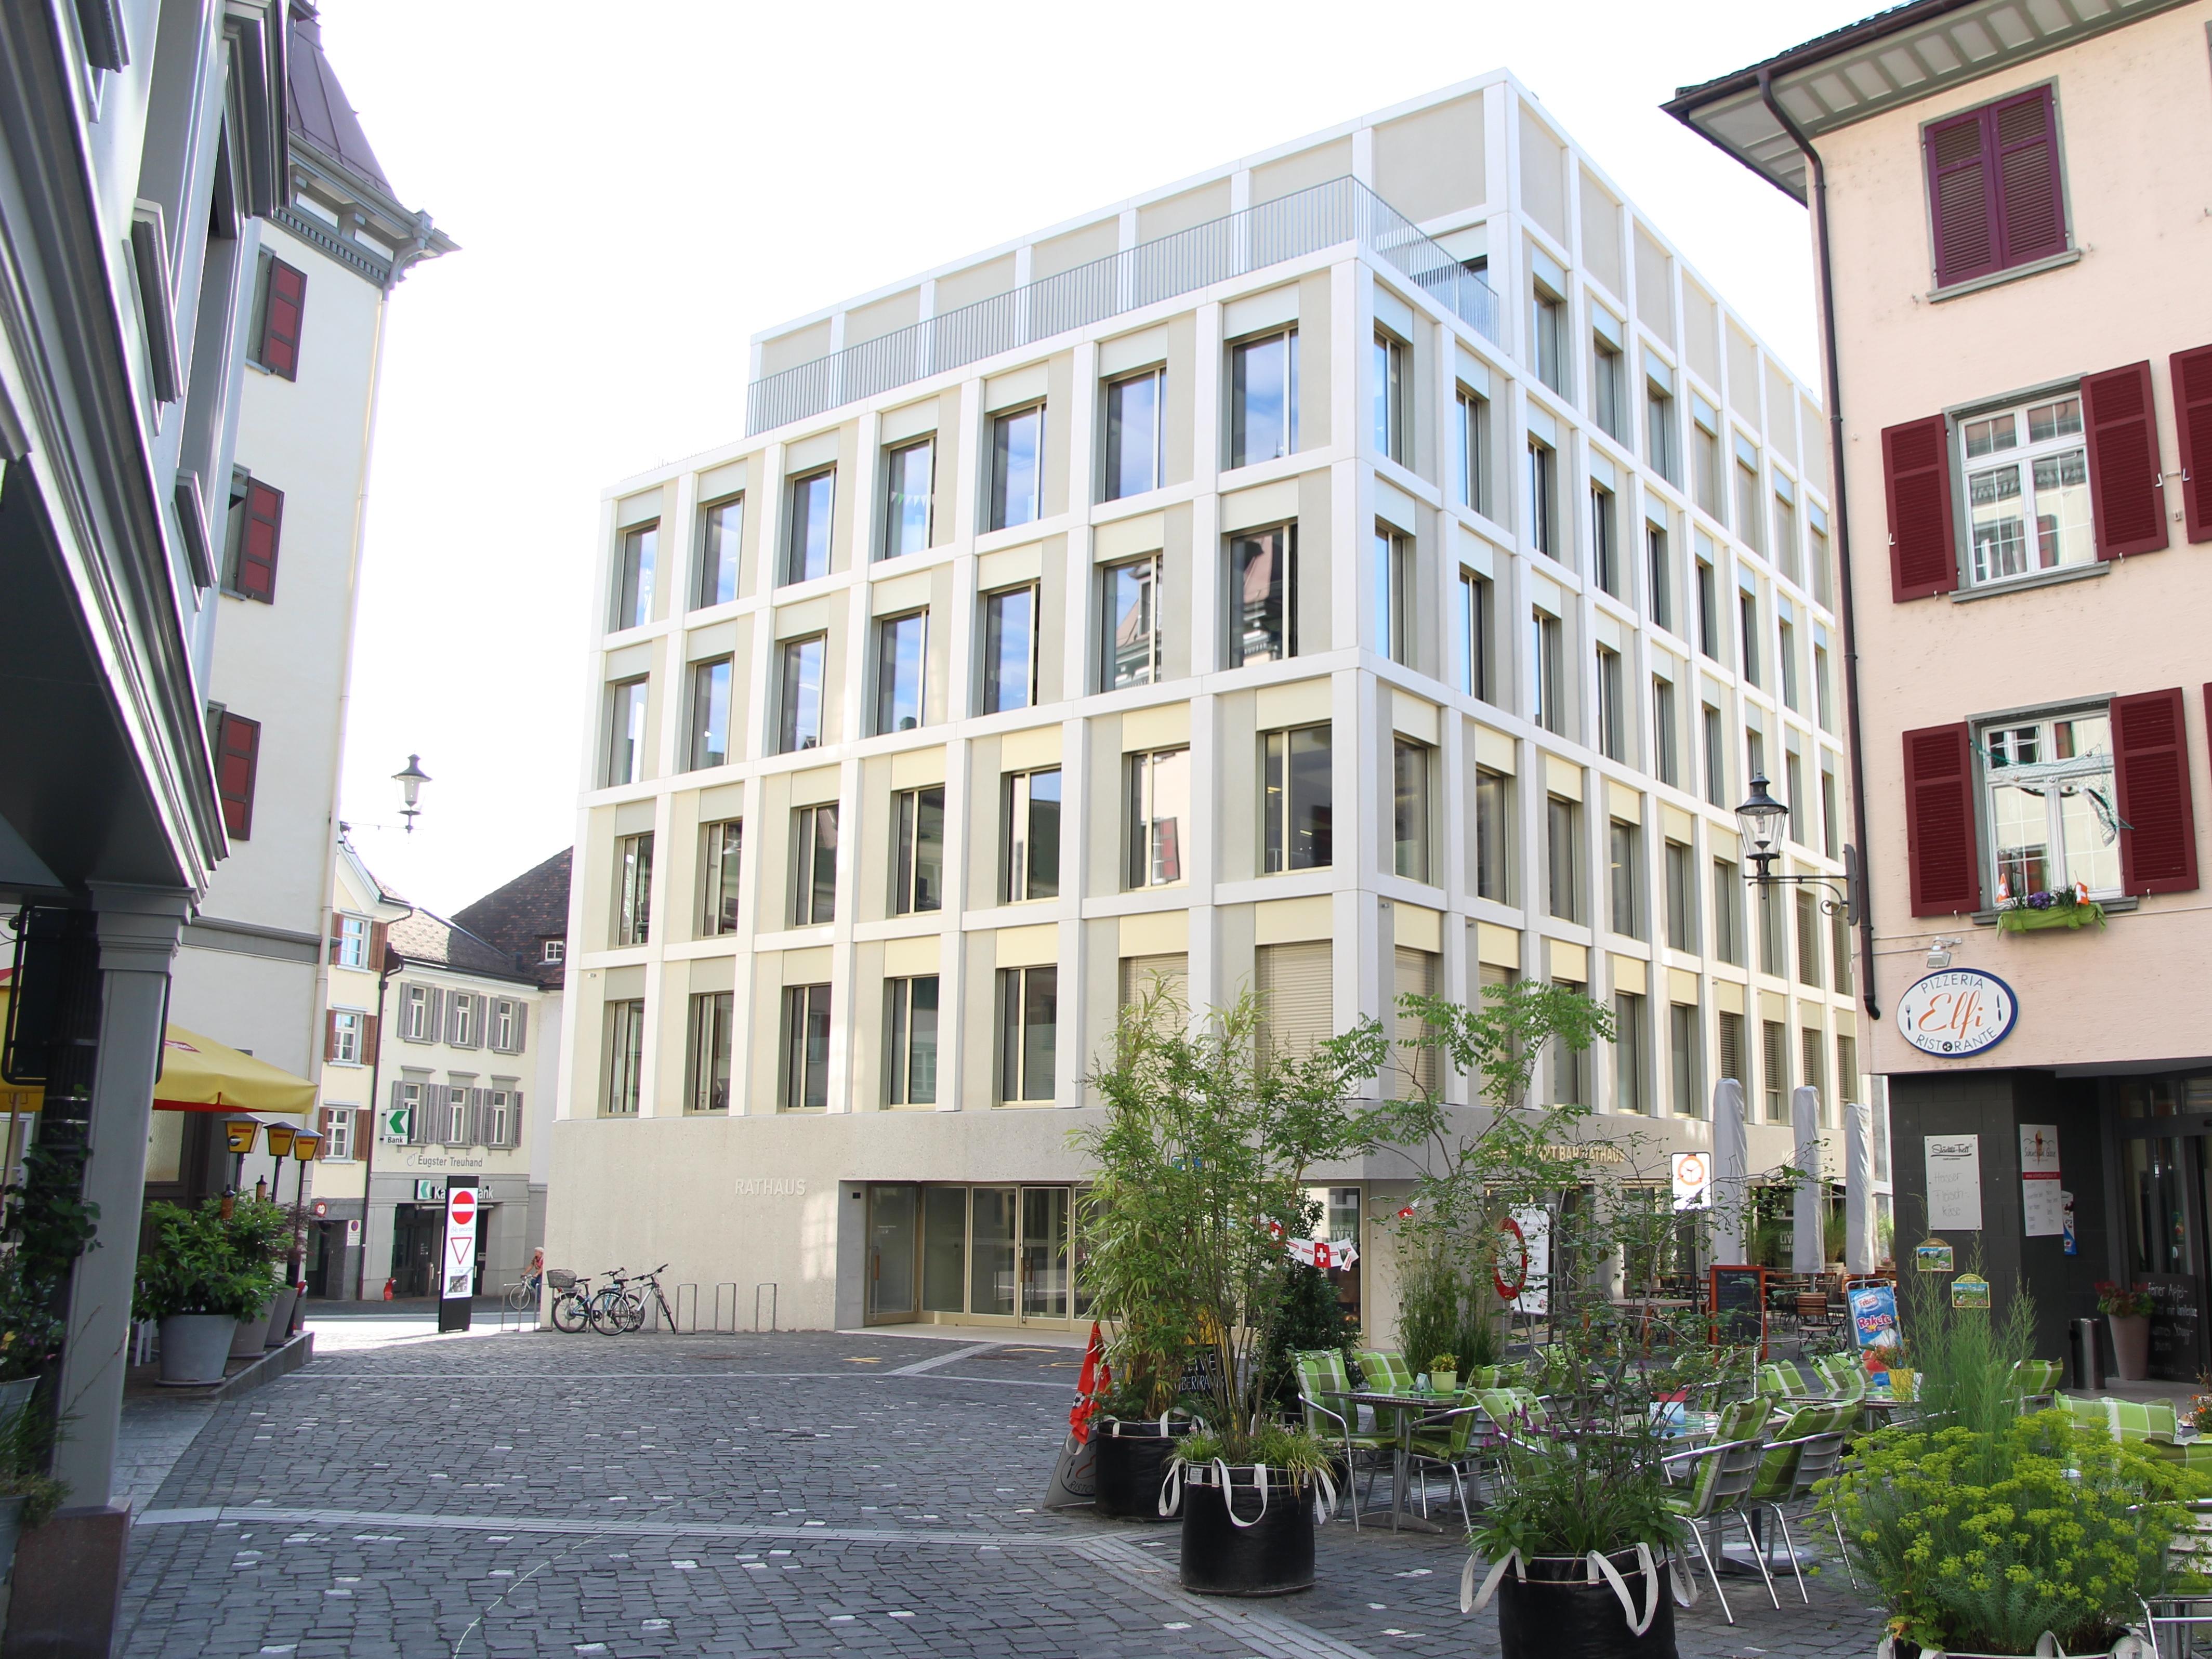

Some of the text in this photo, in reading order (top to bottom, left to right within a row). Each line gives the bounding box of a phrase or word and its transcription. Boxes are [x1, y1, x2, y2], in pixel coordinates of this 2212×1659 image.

[1920, 974, 1984, 994] PIZZERIA
[1918, 990, 1984, 1039] Elfi
[418, 1155, 483, 1167] Eugster Treuhand
[735, 1179, 806, 1196] RATHAUS
[1780, 1235, 1793, 1244] LIV
[1859, 1297, 1876, 1306] Frisco
[1857, 1314, 1892, 1328] Rakete
